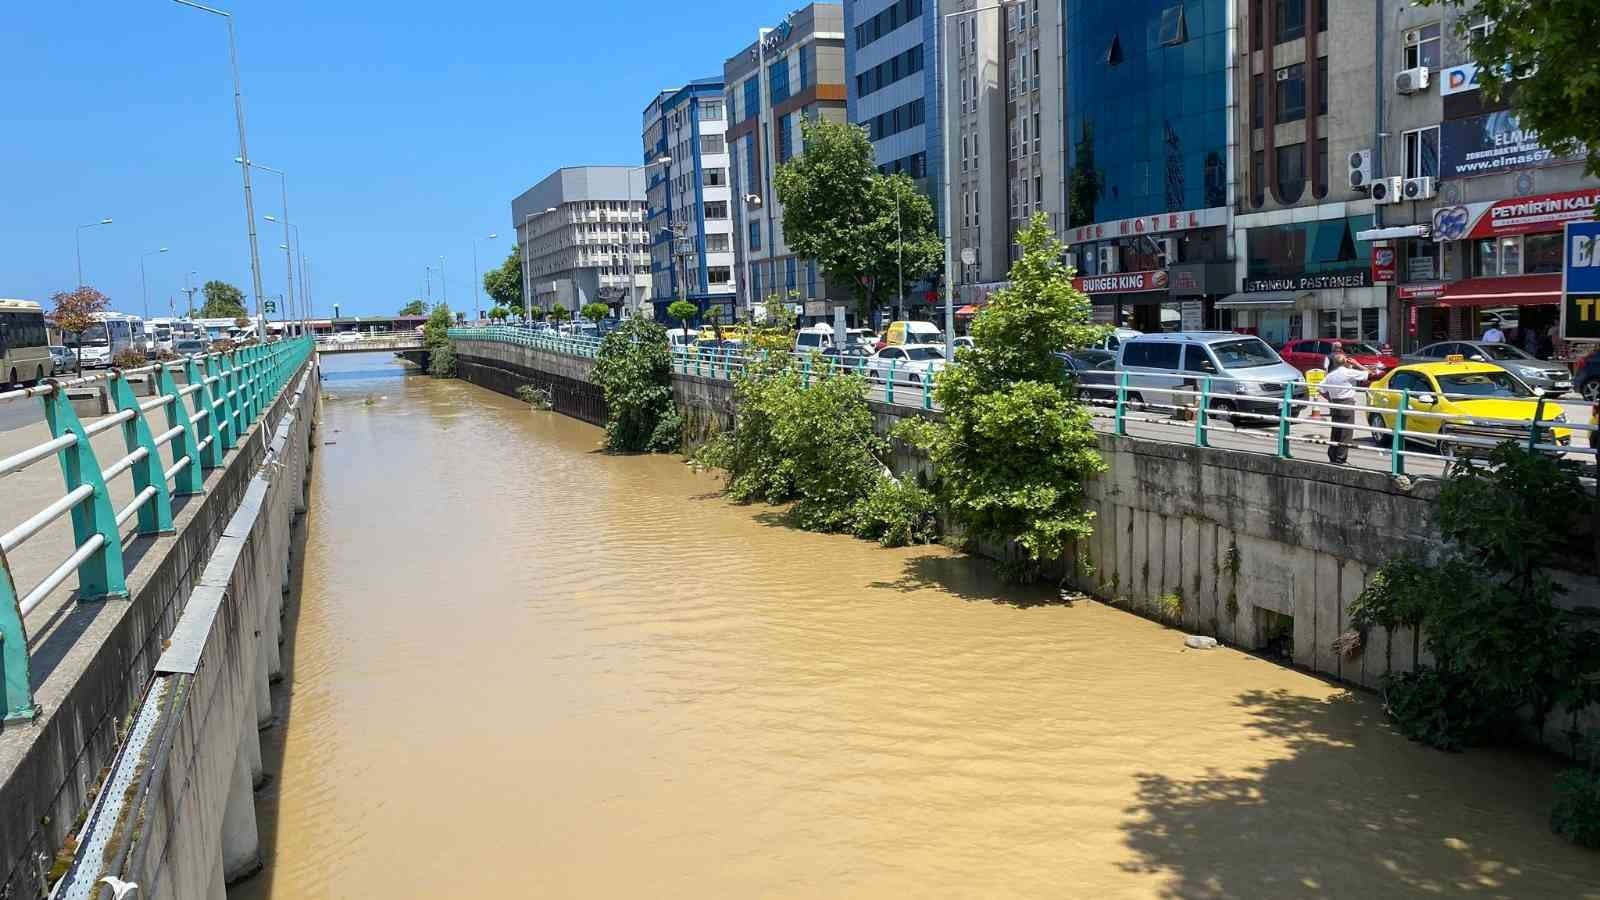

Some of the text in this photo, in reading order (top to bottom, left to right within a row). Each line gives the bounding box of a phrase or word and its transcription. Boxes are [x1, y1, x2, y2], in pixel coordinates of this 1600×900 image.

[1120, 212, 1199, 235] HOTEL
[1082, 274, 1144, 292] BURGER KING
